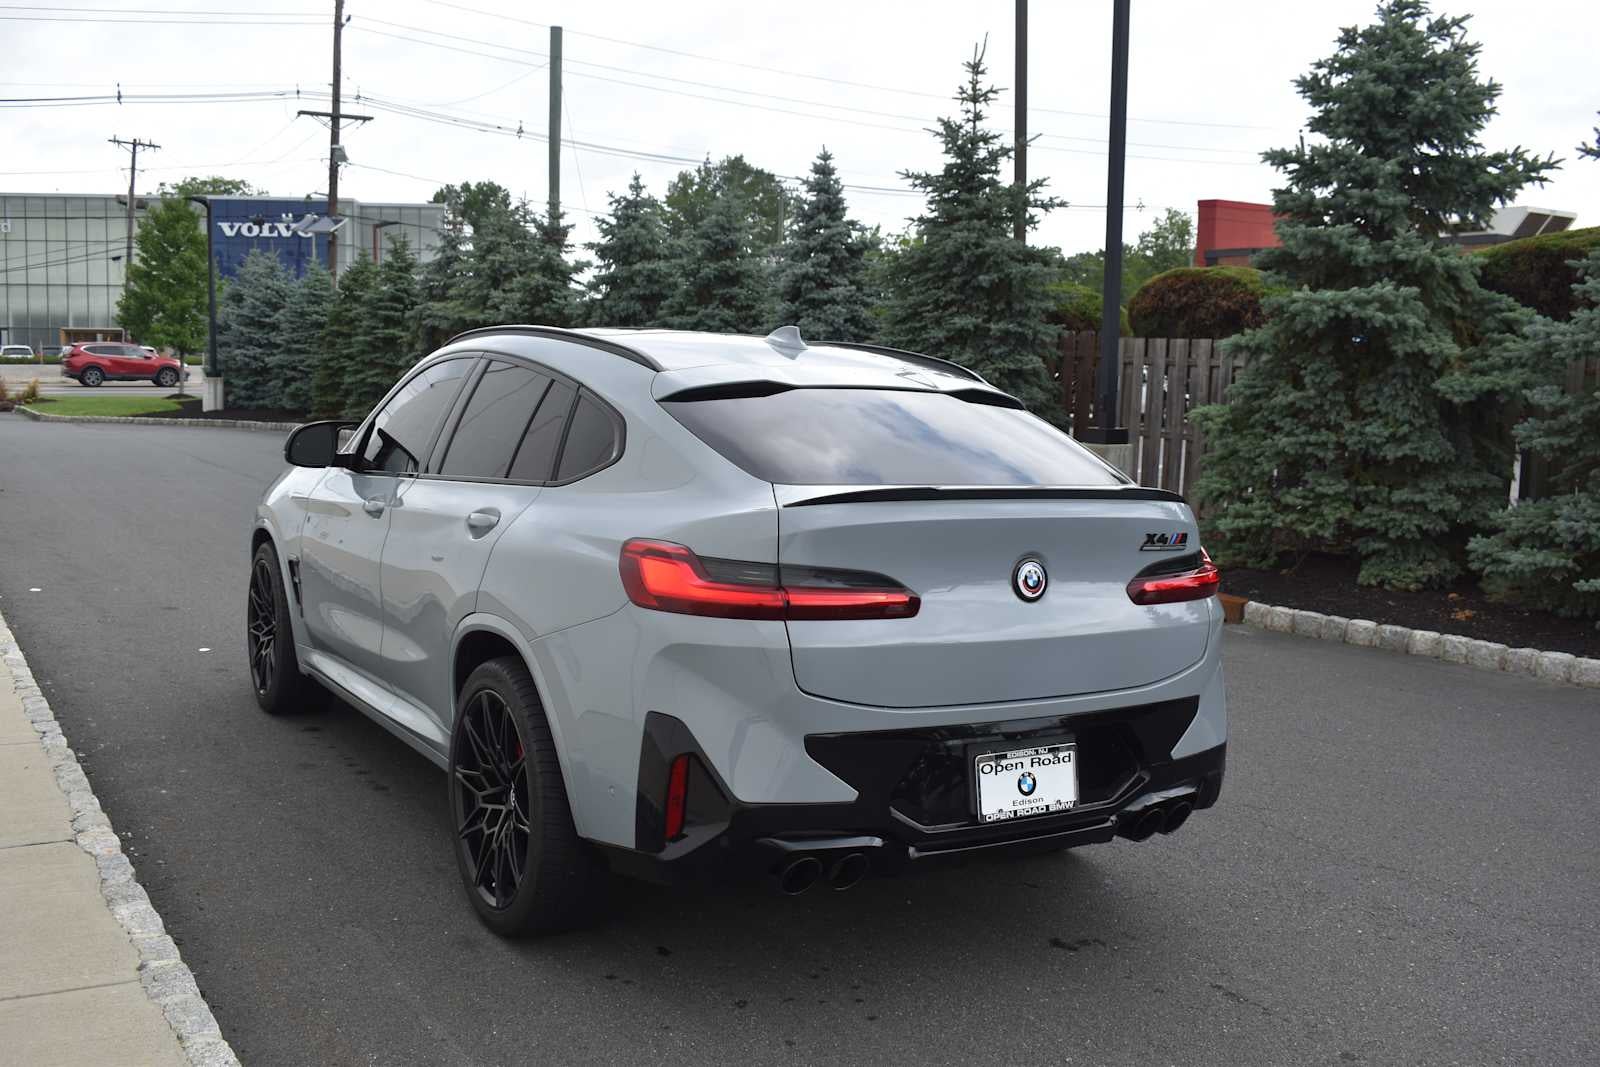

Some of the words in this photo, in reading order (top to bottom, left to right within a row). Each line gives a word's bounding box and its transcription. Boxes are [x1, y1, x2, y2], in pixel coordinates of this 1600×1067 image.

[981, 761, 1024, 775] Open
[1030, 753, 1071, 767] Road
[985, 811, 1014, 822] OPEN
[1017, 806, 1046, 817] ROAD
[1049, 800, 1075, 811] BMW
[1012, 797, 1044, 807] Edison
